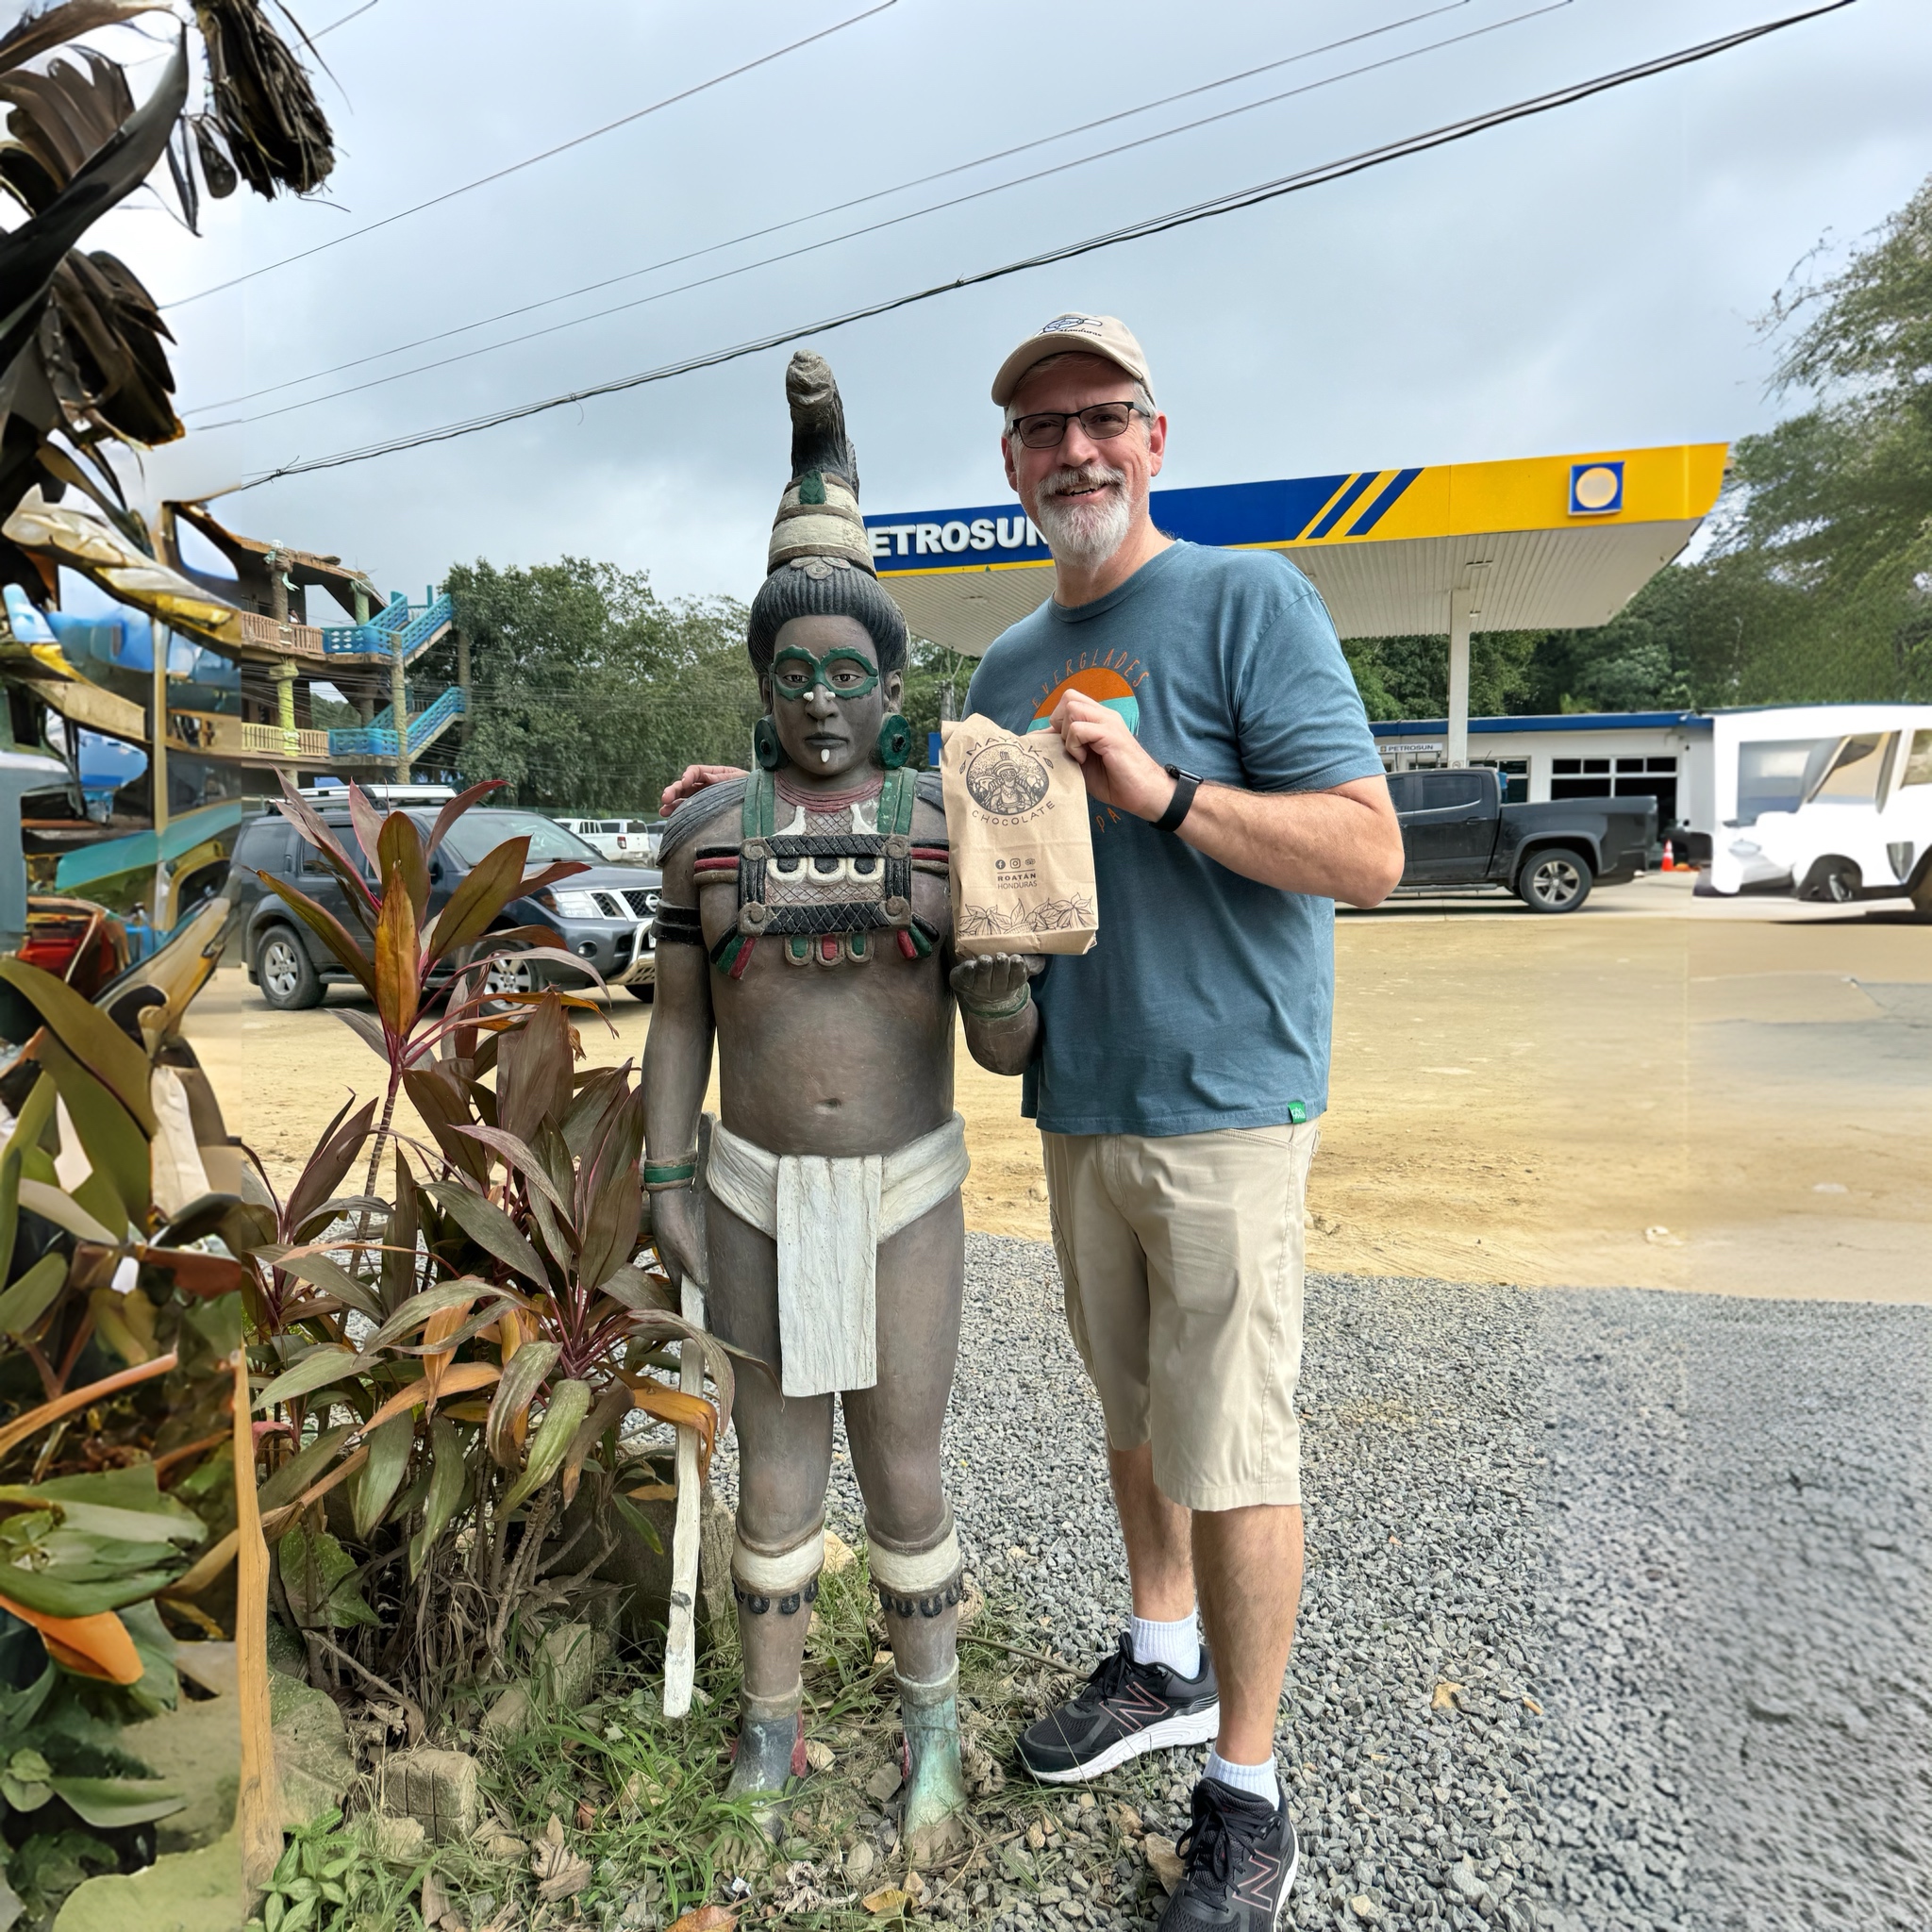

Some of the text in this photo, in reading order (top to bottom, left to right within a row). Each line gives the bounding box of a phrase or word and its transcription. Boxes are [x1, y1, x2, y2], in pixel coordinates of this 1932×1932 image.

[1031, 648, 1149, 708] EVERGLADES
[972, 800, 1056, 826] CHOCOLATE
[997, 872, 1037, 881] ROATÁN
[997, 879, 1038, 890] HONDURAS
